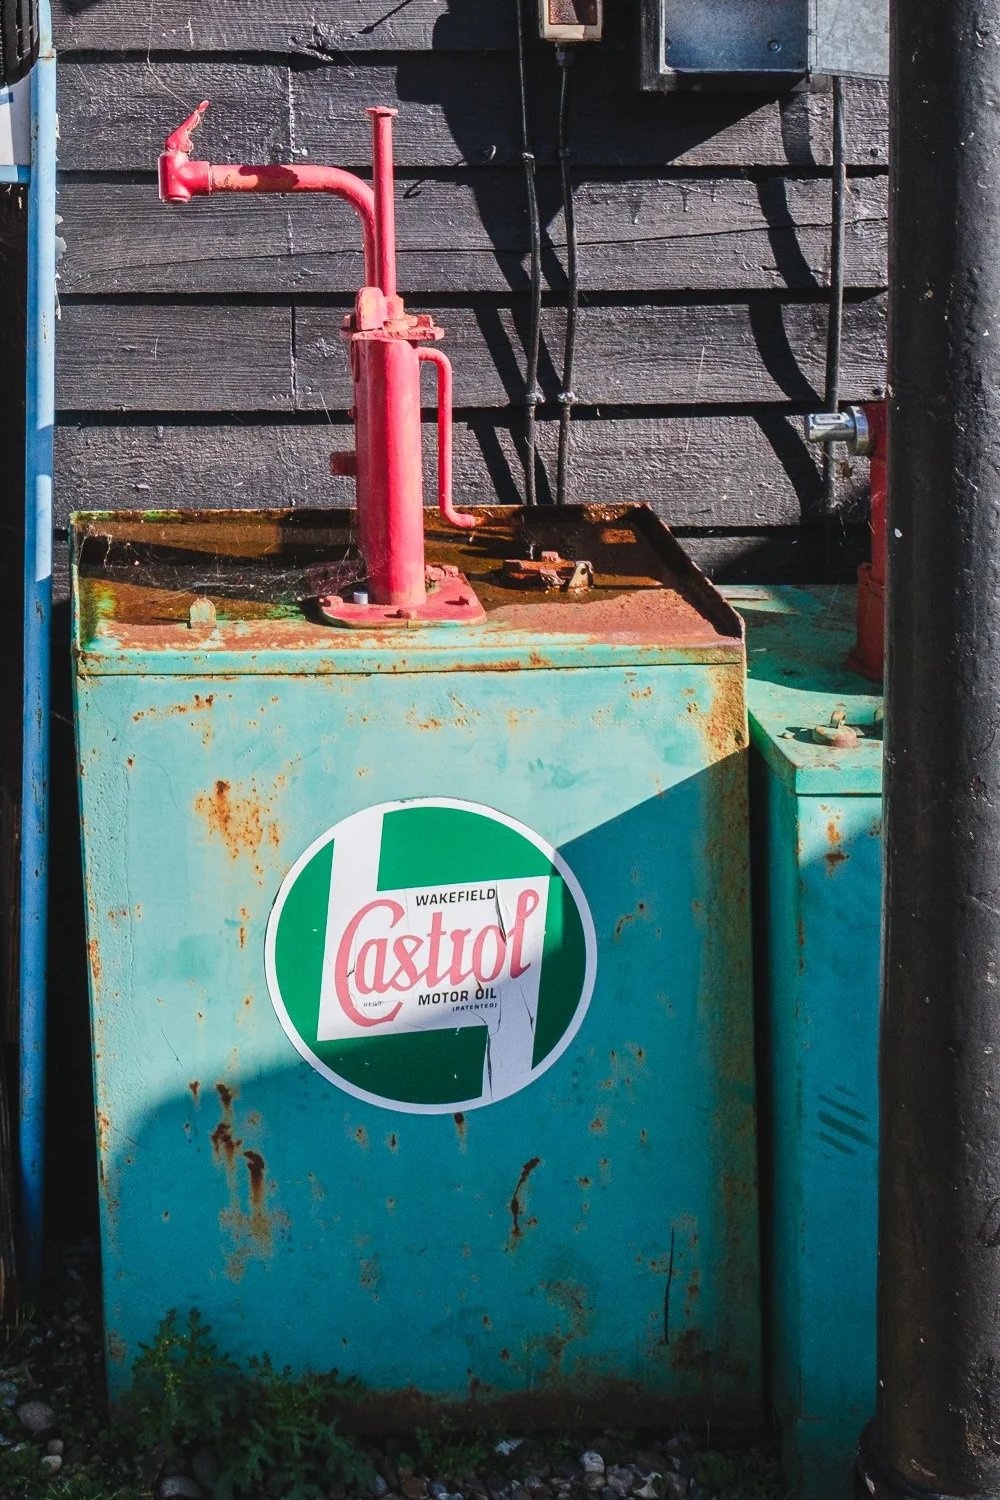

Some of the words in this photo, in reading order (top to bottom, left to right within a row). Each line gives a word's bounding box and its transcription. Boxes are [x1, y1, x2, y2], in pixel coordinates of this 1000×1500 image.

[415, 888, 496, 907] WAKEFIELD
[334, 888, 540, 1028] Castrol
[418, 990, 469, 1006] MOTOR
[475, 987, 497, 1000] OIL
[452, 1002, 498, 1013] (PATENTED)
